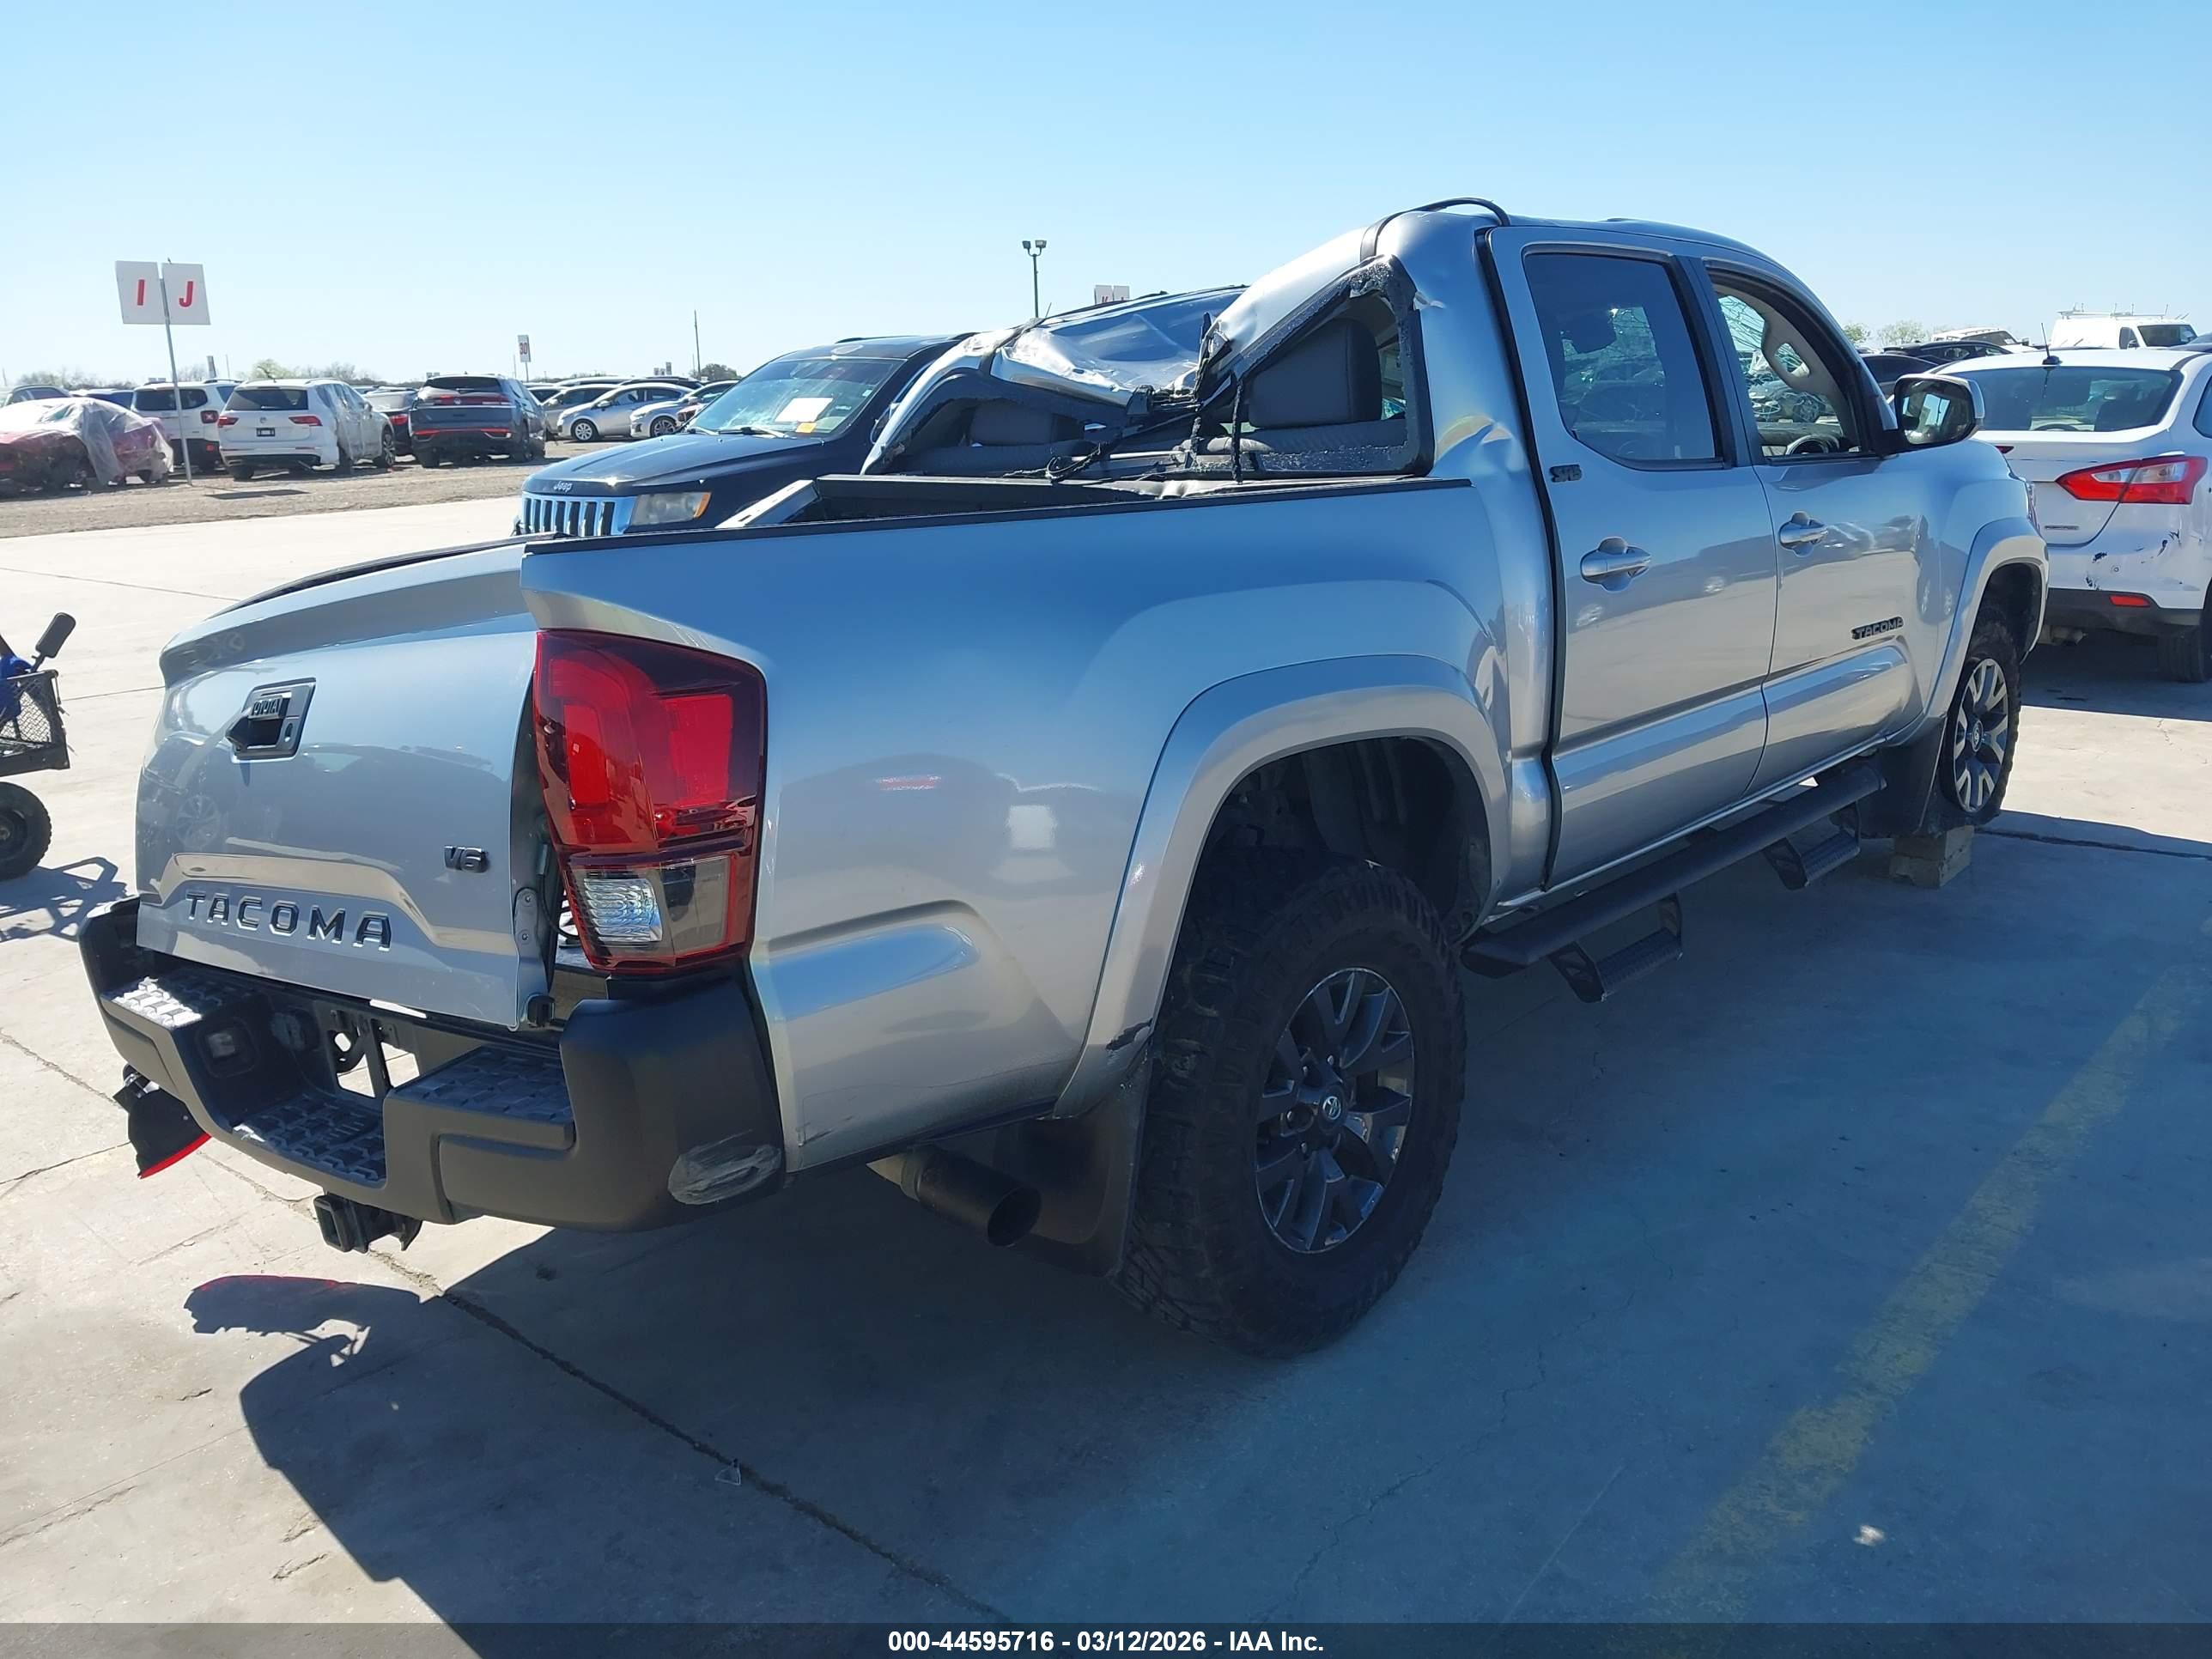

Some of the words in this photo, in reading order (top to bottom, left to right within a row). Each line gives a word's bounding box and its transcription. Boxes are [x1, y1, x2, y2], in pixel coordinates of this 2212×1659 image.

[137, 279, 145, 306] I
[179, 281, 194, 307] J
[553, 480, 573, 493] Jeep
[1852, 617, 1904, 639] TACOMA
[444, 846, 489, 873] V6
[185, 889, 393, 952] TACOMA
